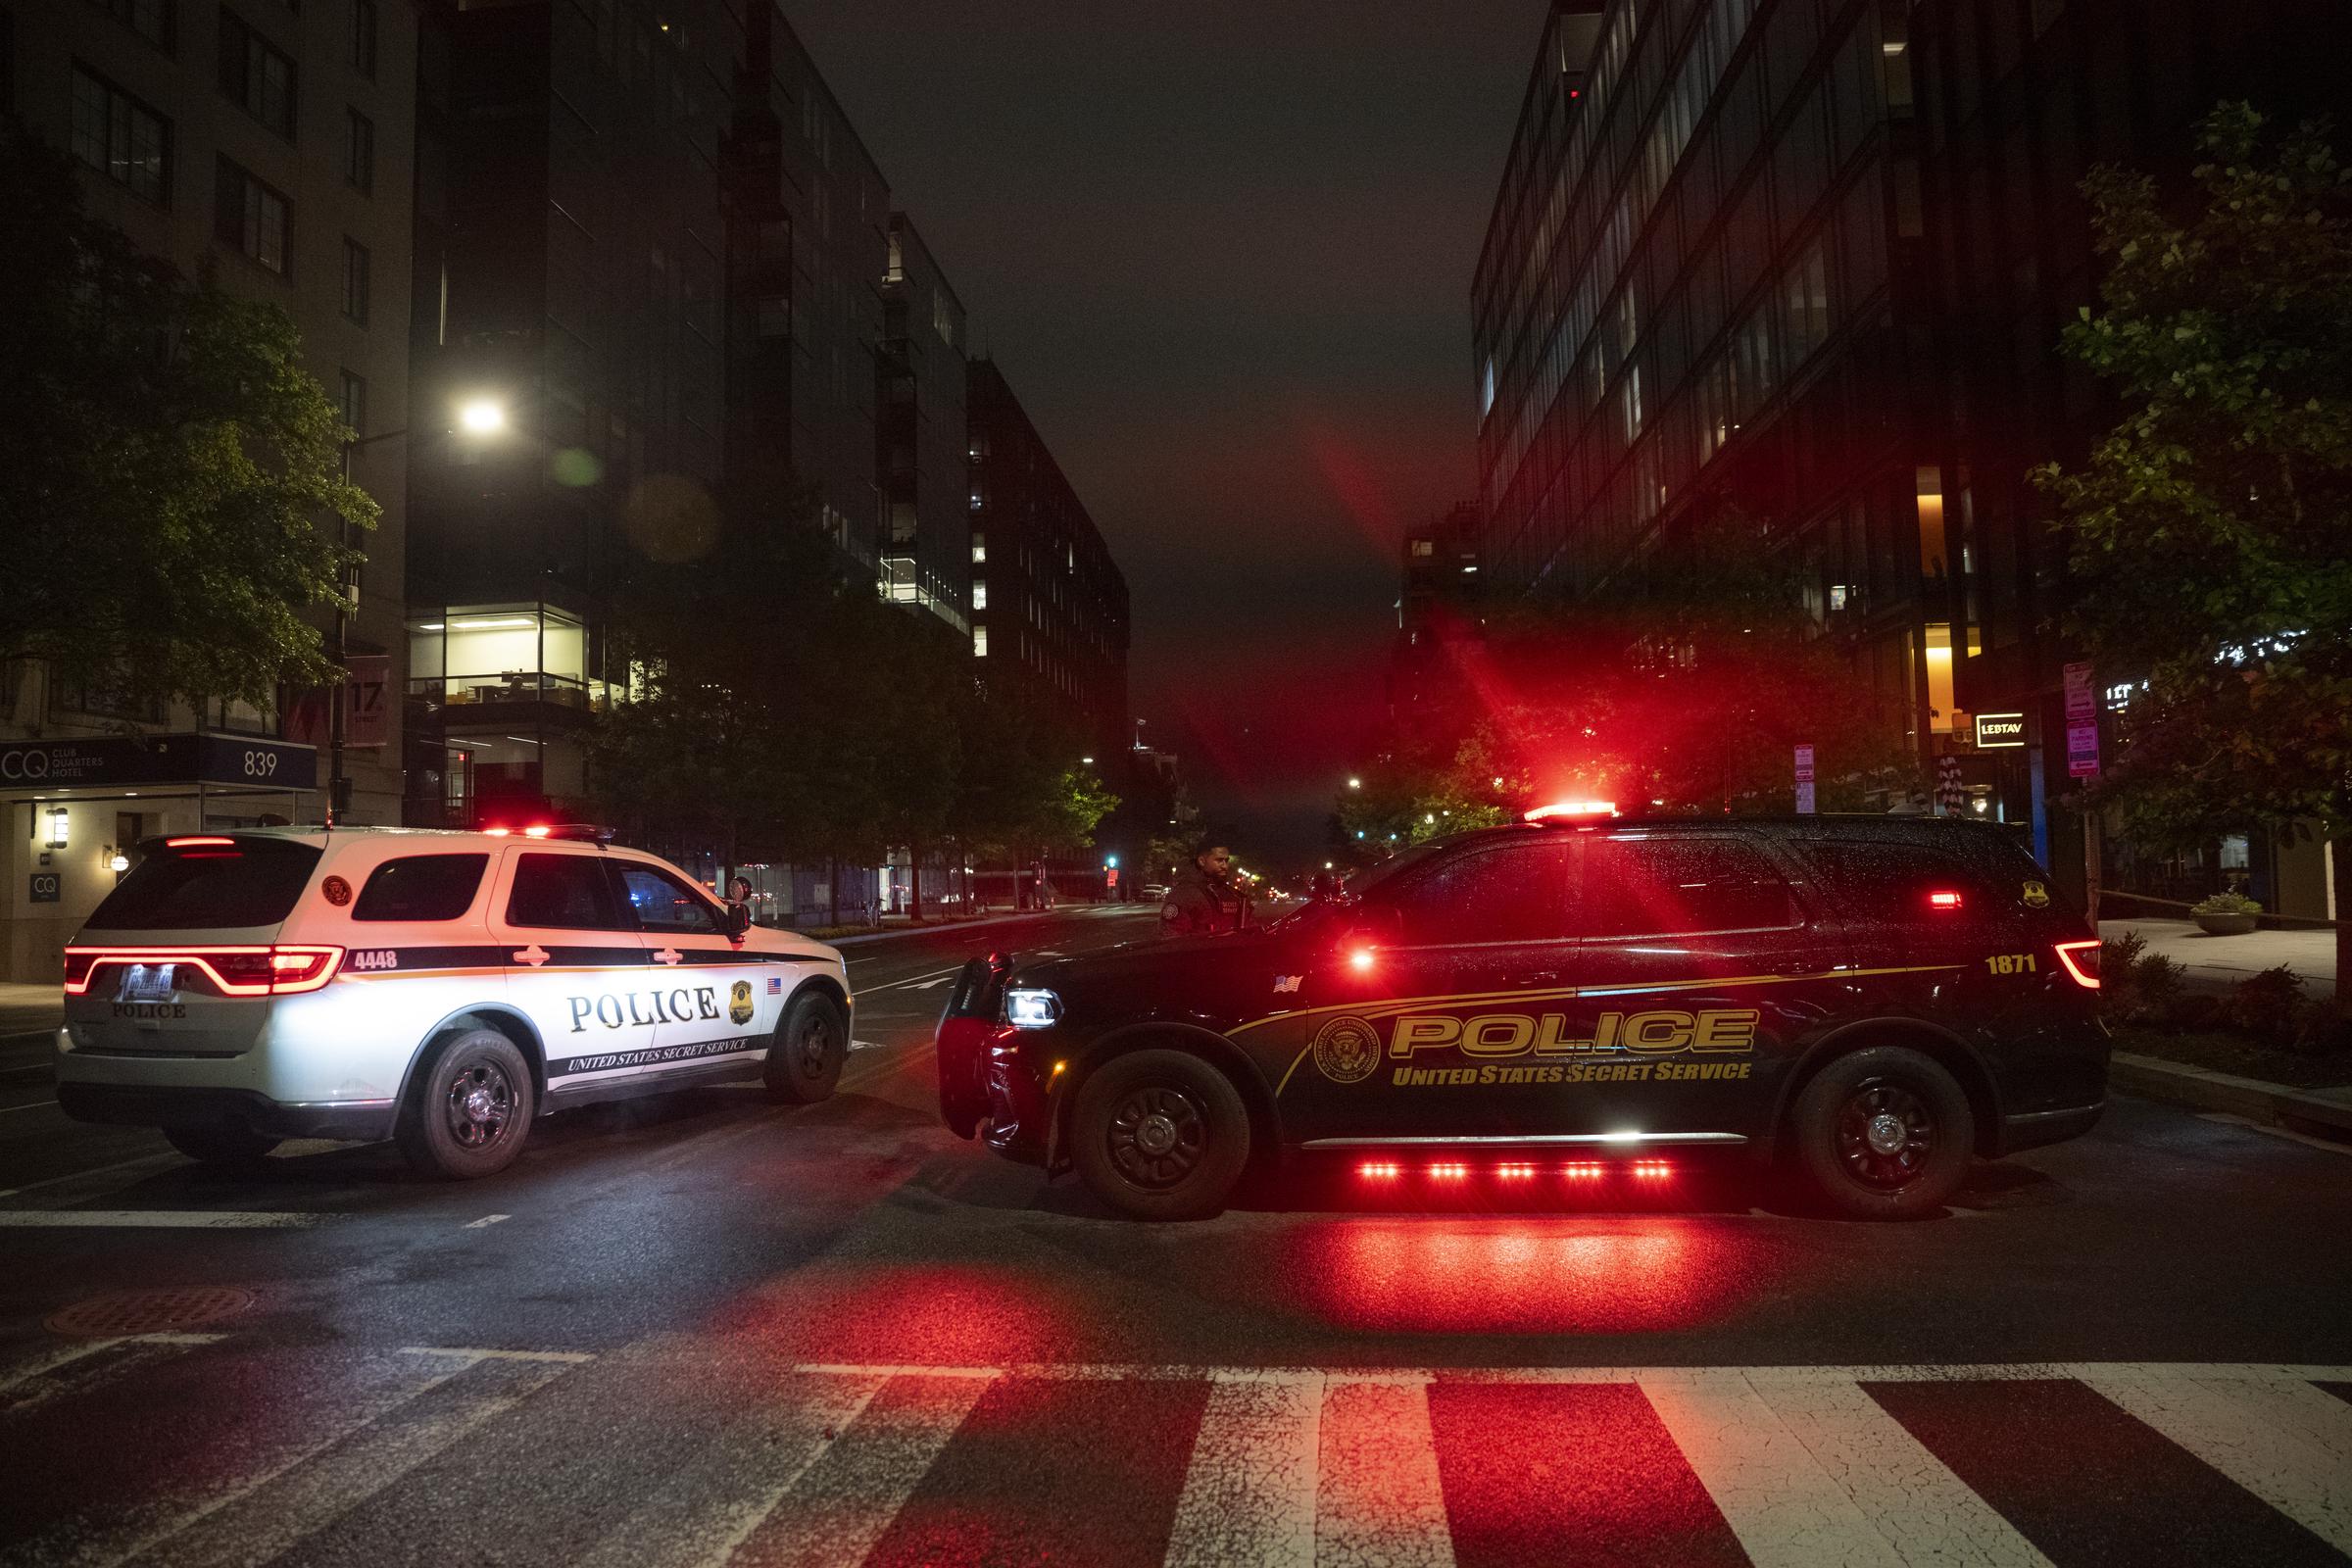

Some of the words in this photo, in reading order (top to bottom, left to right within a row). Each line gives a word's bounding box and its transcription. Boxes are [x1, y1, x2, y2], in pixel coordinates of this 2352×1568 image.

[52, 748, 77, 758] CLUB
[52, 758, 103, 767] QUARTERS
[245, 751, 277, 777] 839
[2, 750, 48, 779] CQ
[52, 767, 84, 777] HOTEL
[34, 877, 56, 893] CQ
[355, 951, 398, 969] 4448
[1984, 953, 2037, 975] 1871
[113, 1004, 187, 1018] POLICE
[566, 986, 720, 1033] POLICE
[1389, 1009, 1760, 1058] POLICE
[568, 1054, 616, 1071] UNITED
[616, 1050, 662, 1065] STATES
[662, 1044, 706, 1060] SECRET
[705, 1039, 748, 1054] SERVICE
[1393, 1067, 1478, 1086] UNITED
[1480, 1065, 1564, 1084] STATES
[1566, 1063, 1654, 1083] SECRET
[1654, 1061, 1752, 1080] SERVICE
